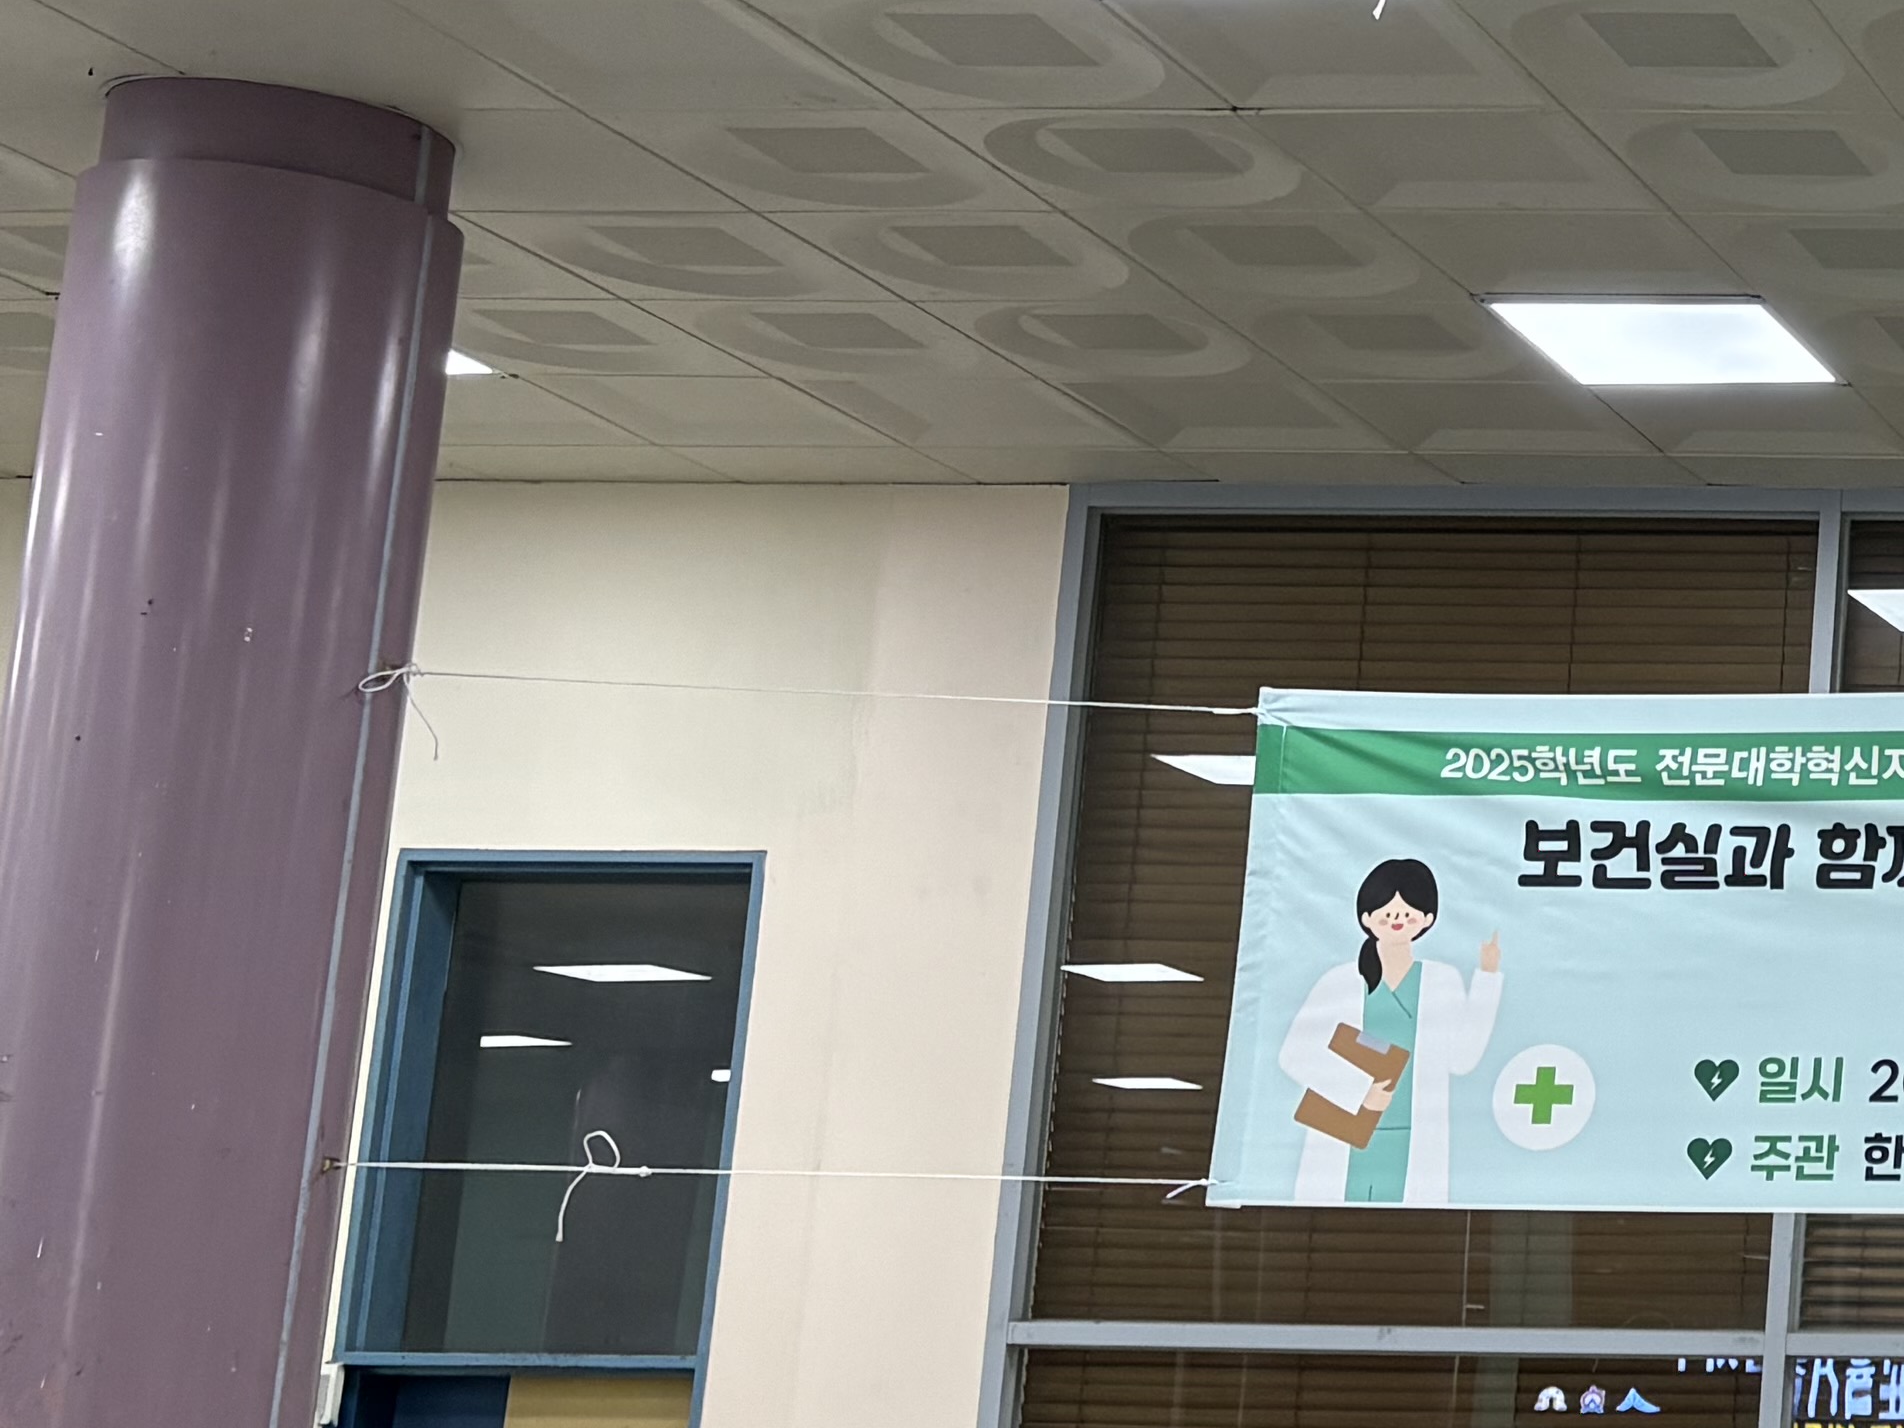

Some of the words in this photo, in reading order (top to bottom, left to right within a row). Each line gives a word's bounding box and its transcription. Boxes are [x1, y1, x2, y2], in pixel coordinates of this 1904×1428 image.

[1440, 745, 1642, 786] 2025학년도
[1517, 819, 1795, 890] 보건실과
[1758, 1056, 1844, 1103] 일시
[1750, 1134, 1840, 1181] 주관
